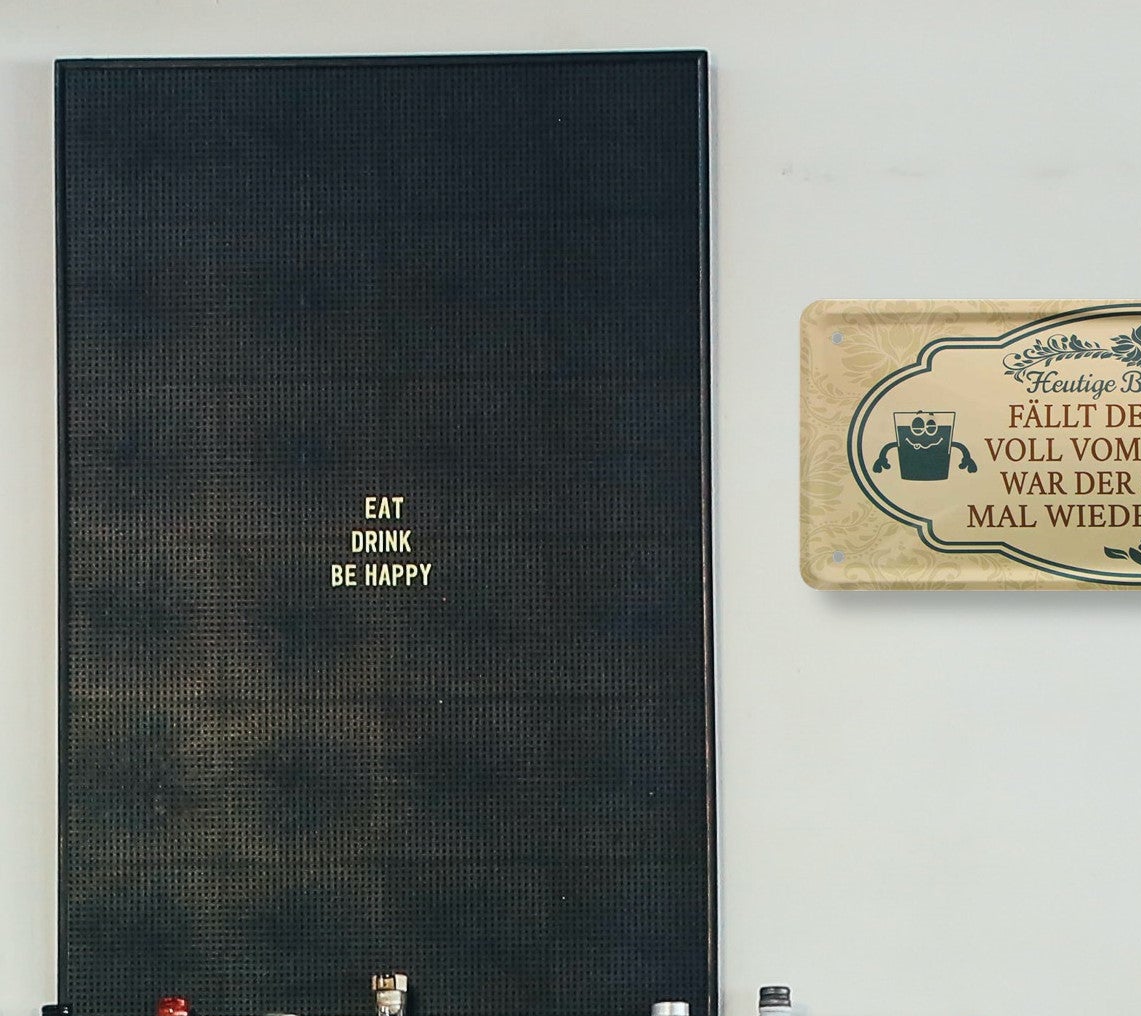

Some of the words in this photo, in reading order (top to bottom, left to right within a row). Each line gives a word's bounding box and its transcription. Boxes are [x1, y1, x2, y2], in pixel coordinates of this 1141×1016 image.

[1027, 369, 1117, 401] Heutige
[1008, 398, 1097, 429] FÄLLT
[984, 437, 1063, 462] VOLL
[1073, 437, 1141, 462] VOM
[1000, 470, 1069, 496] WAR
[1074, 471, 1136, 496] DER
[365, 496, 404, 520] EAT
[966, 504, 1039, 529] MAL
[351, 529, 412, 554] DRINK
[331, 563, 358, 587] BE
[365, 563, 432, 587] HAPPY
